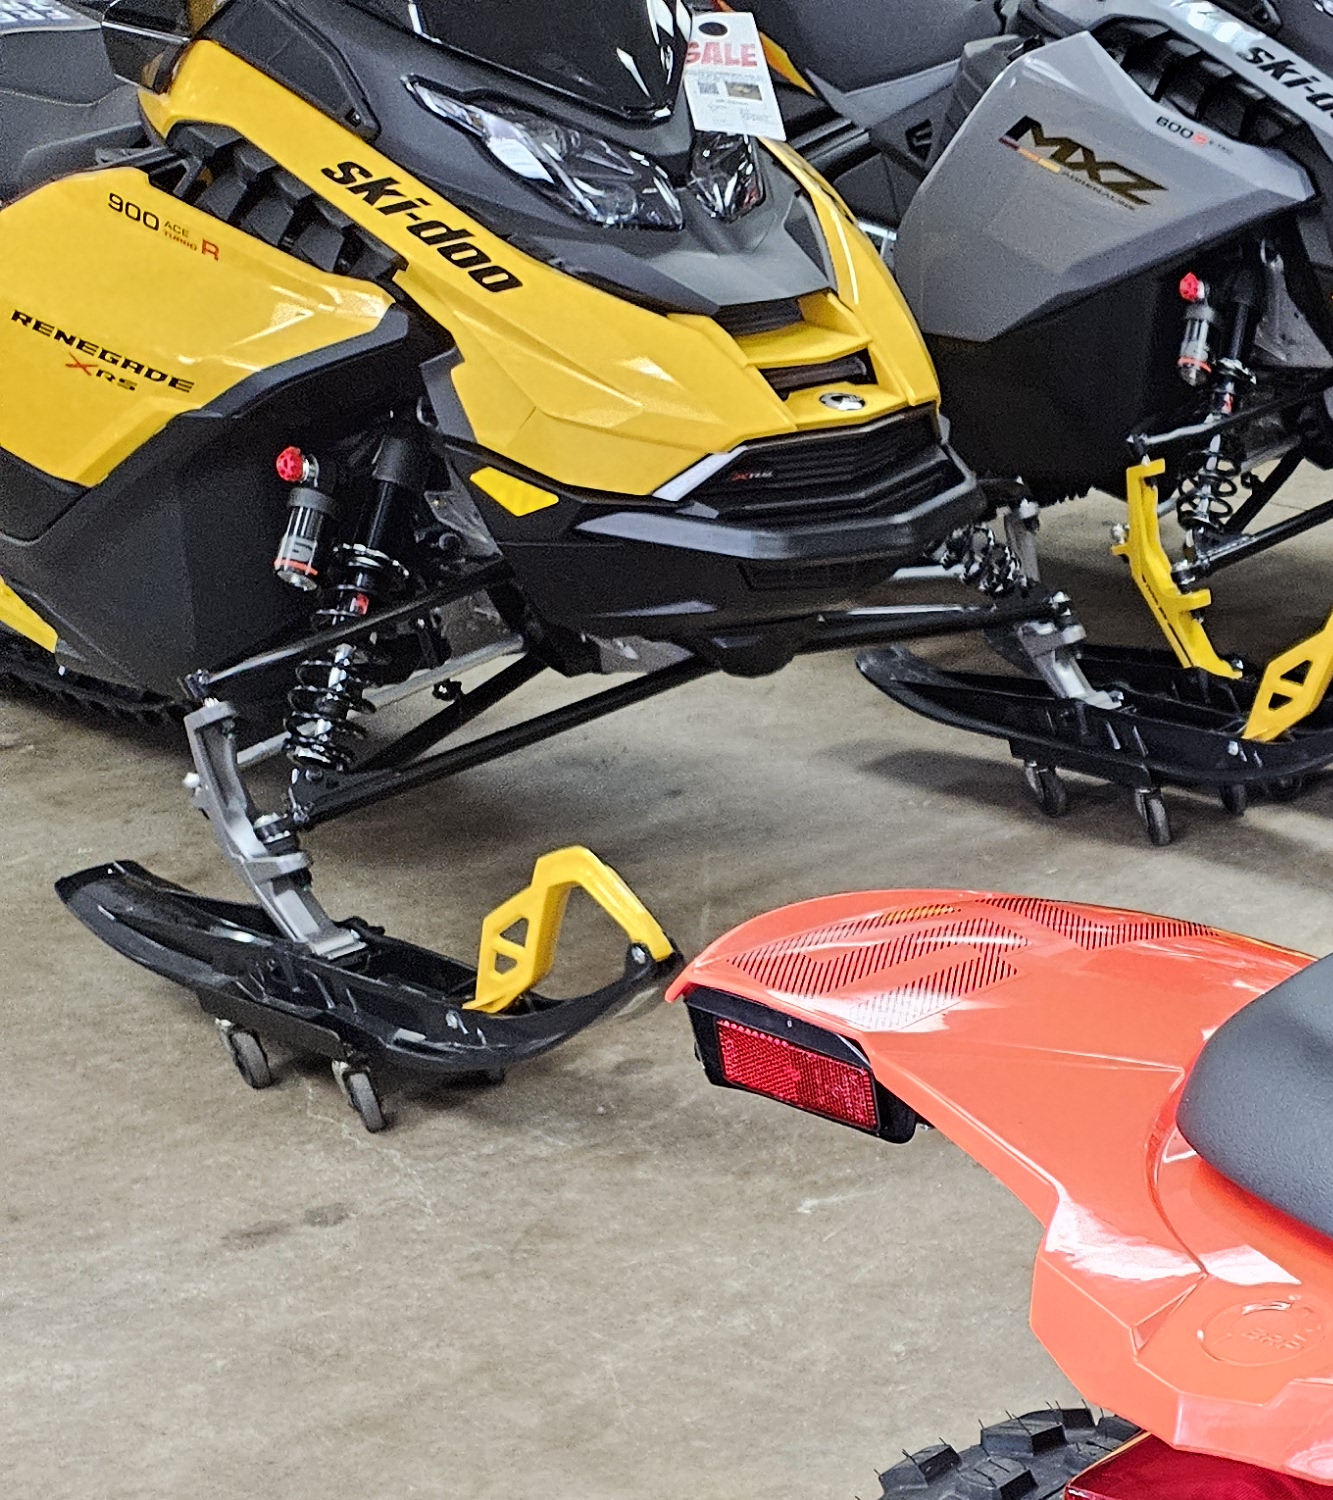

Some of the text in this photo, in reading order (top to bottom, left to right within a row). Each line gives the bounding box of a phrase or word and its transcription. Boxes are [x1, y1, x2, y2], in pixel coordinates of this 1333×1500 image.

[685, 42, 757, 67] SALE
[1156, 116, 1194, 139] 600
[1004, 115, 1169, 206] MXZ
[108, 192, 159, 231] 900
[164, 220, 190, 238] ACE
[321, 159, 523, 293] ski-doo
[11, 309, 195, 393] RENEGADE
